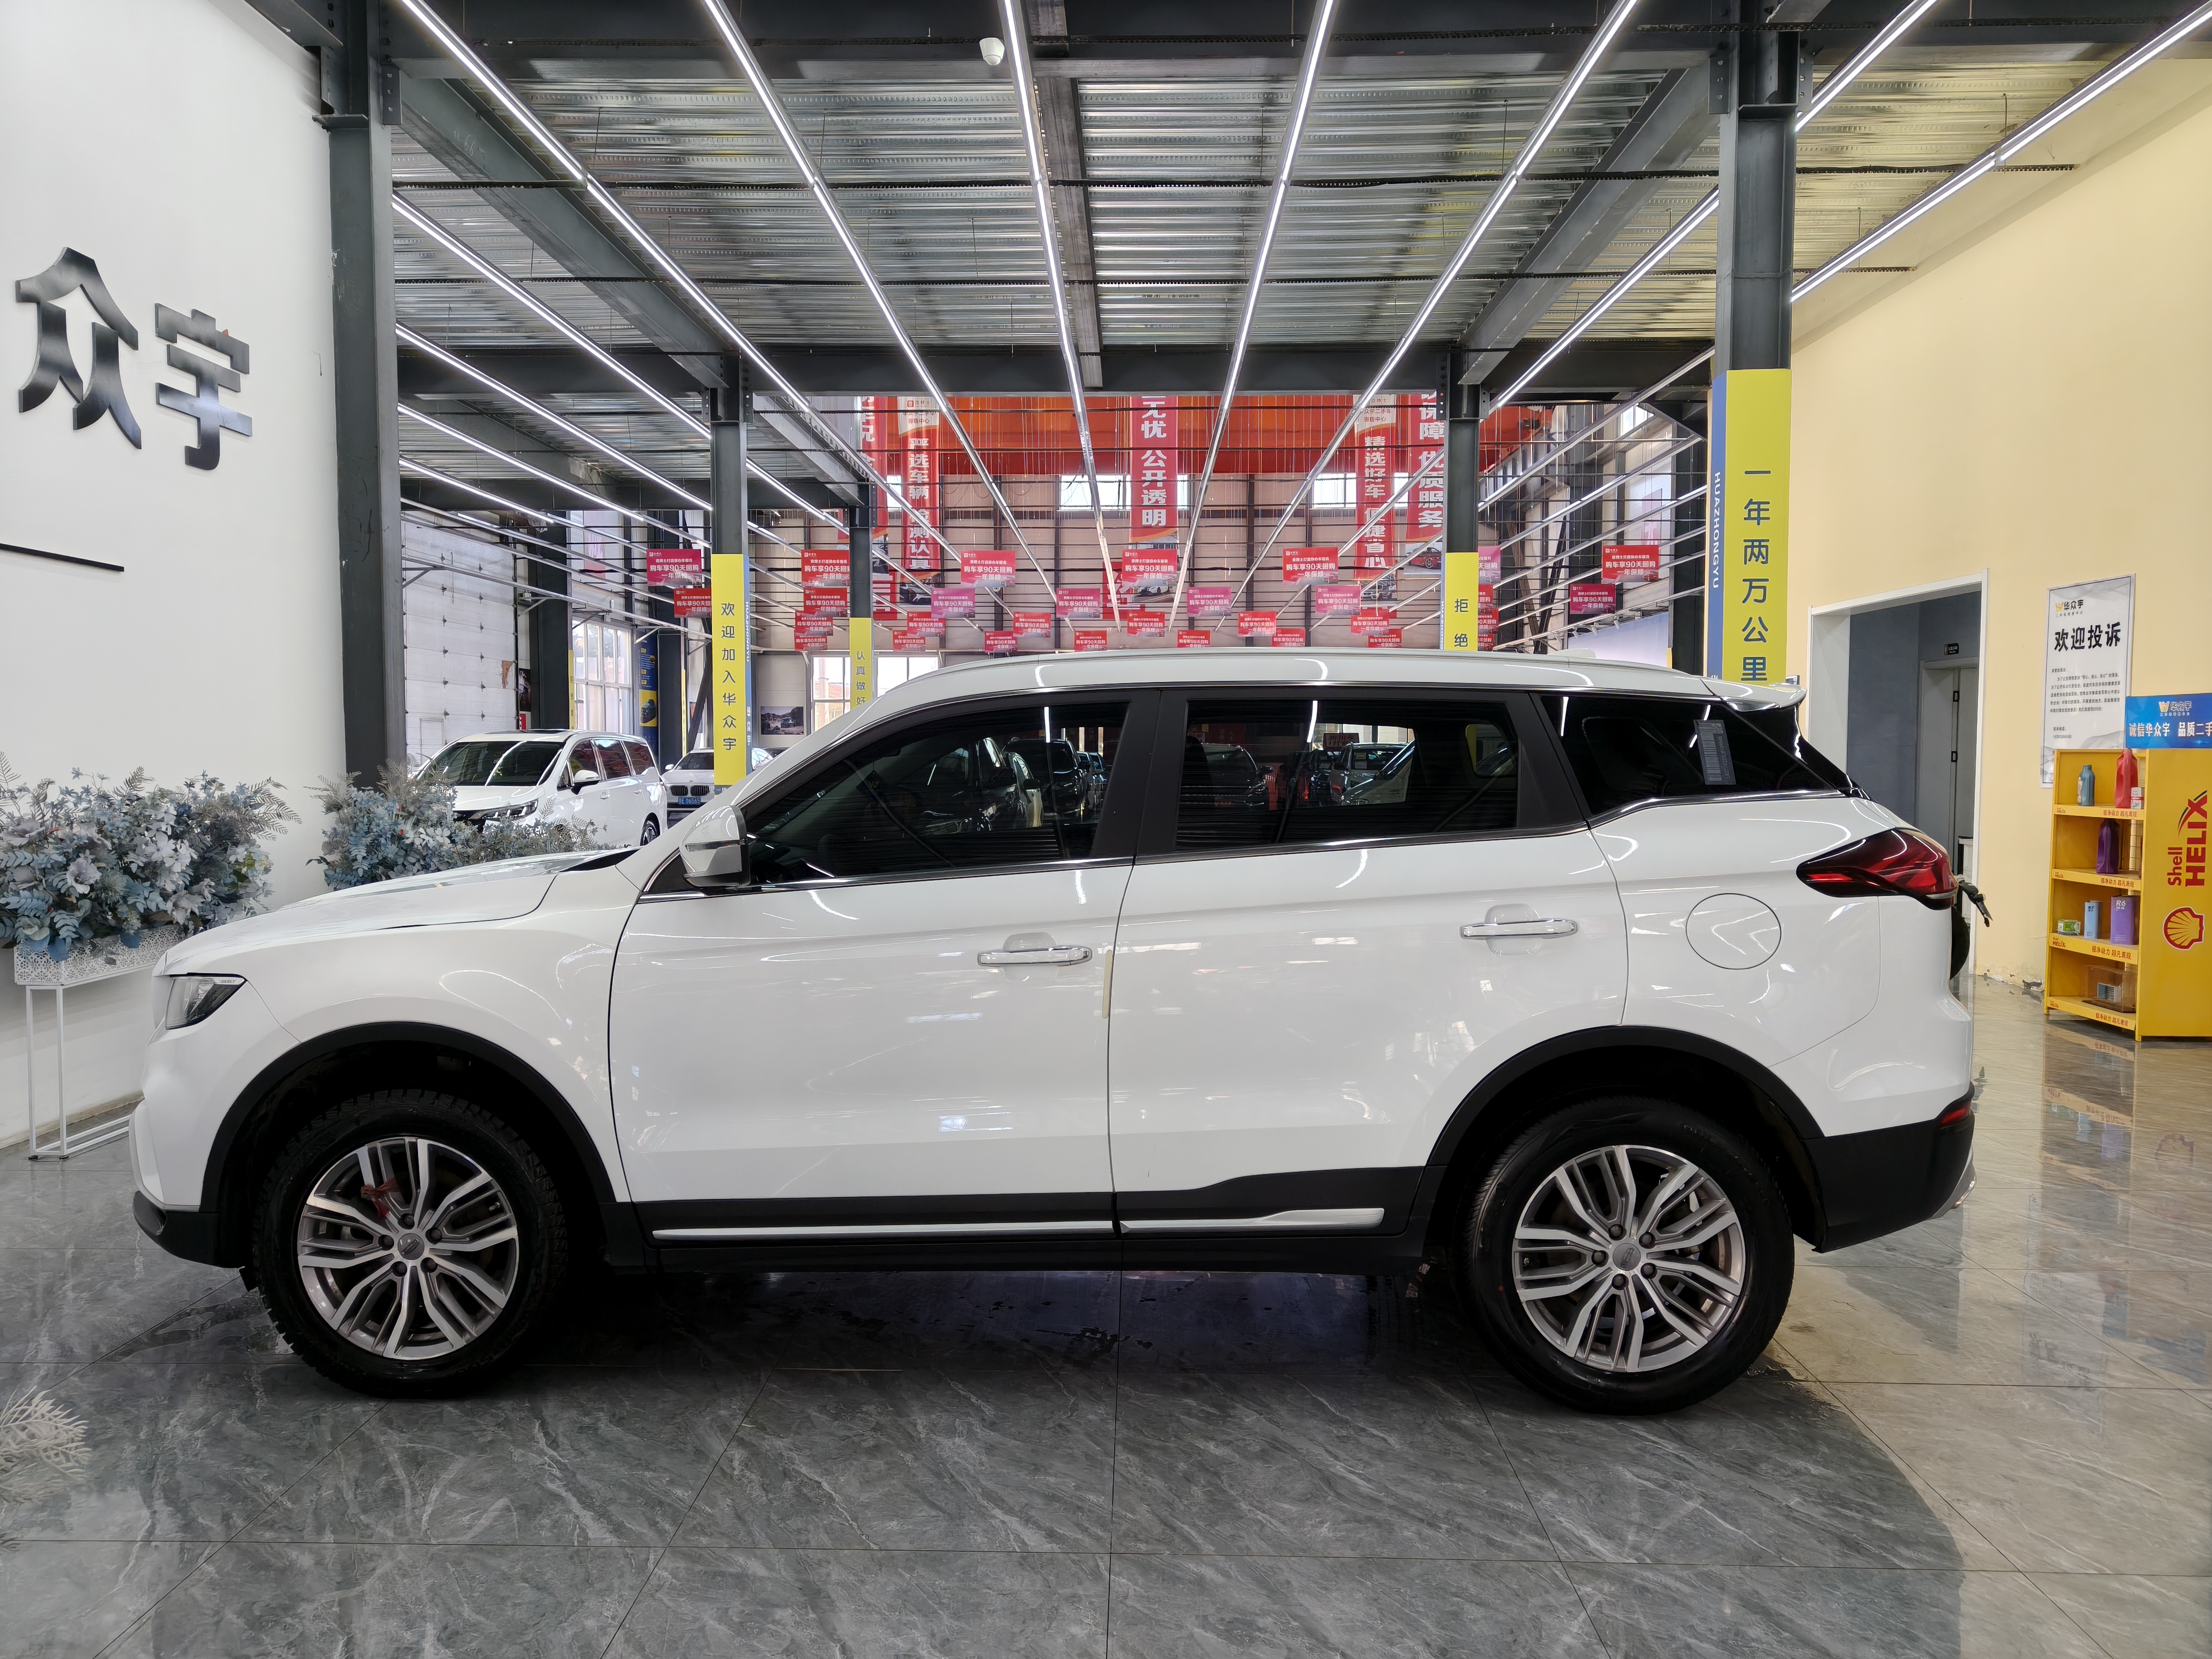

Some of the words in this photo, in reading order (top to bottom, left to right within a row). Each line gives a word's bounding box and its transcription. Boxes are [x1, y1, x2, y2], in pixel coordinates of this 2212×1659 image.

[16, 247, 253, 470] 众宇
[1141, 396, 1166, 439] 无忧
[1141, 450, 1166, 527] 公开透明
[1365, 436, 1386, 498] 精选好车
[1712, 471, 1721, 589] HUAZHONGYU
[1741, 470, 1771, 682] 一年两万公里
[2064, 599, 2083, 610] 华众宇
[1454, 598, 1468, 648] 拒绝
[2054, 622, 2121, 652] 欢迎投诉
[721, 603, 737, 751] 欢迎加入华众宇
[856, 651, 866, 705] 认真做好
[2129, 722, 2170, 737] 诚信华众宇
[2178, 721, 2212, 737] 品质二手
[2167, 847, 2183, 886] Shell
[2185, 794, 2208, 887] HELIX
